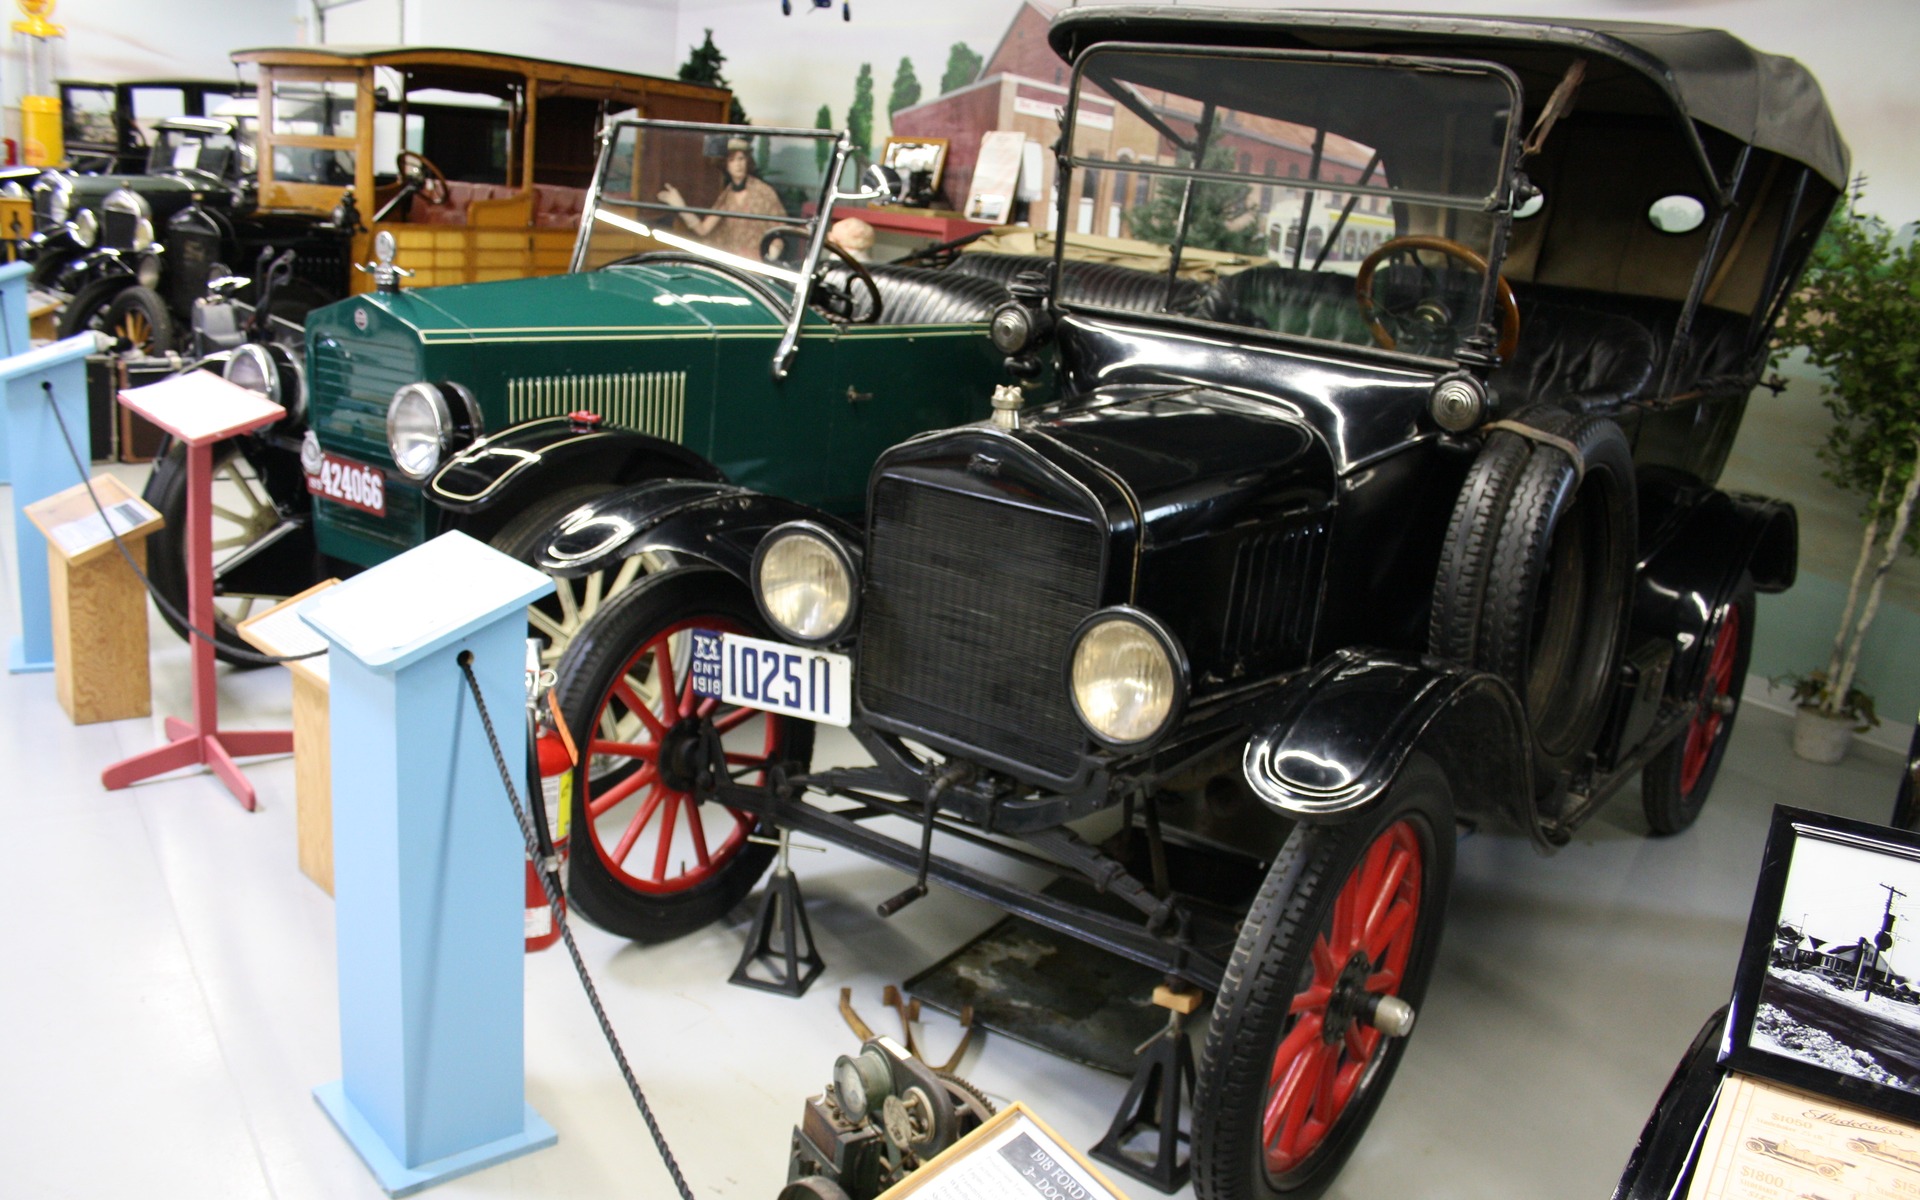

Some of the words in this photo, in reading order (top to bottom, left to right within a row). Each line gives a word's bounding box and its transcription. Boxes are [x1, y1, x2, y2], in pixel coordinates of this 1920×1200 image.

[320, 460, 384, 510] 424066
[693, 661, 721, 677] ONT
[730, 644, 830, 715] 102511
[693, 676, 722, 695] 1918
[1801, 1109, 1914, 1138] Studebaker
[1030, 1148, 1055, 1171] 1918
[1050, 1167, 1086, 1200] FORD
[1740, 1165, 1784, 1188] $1800
